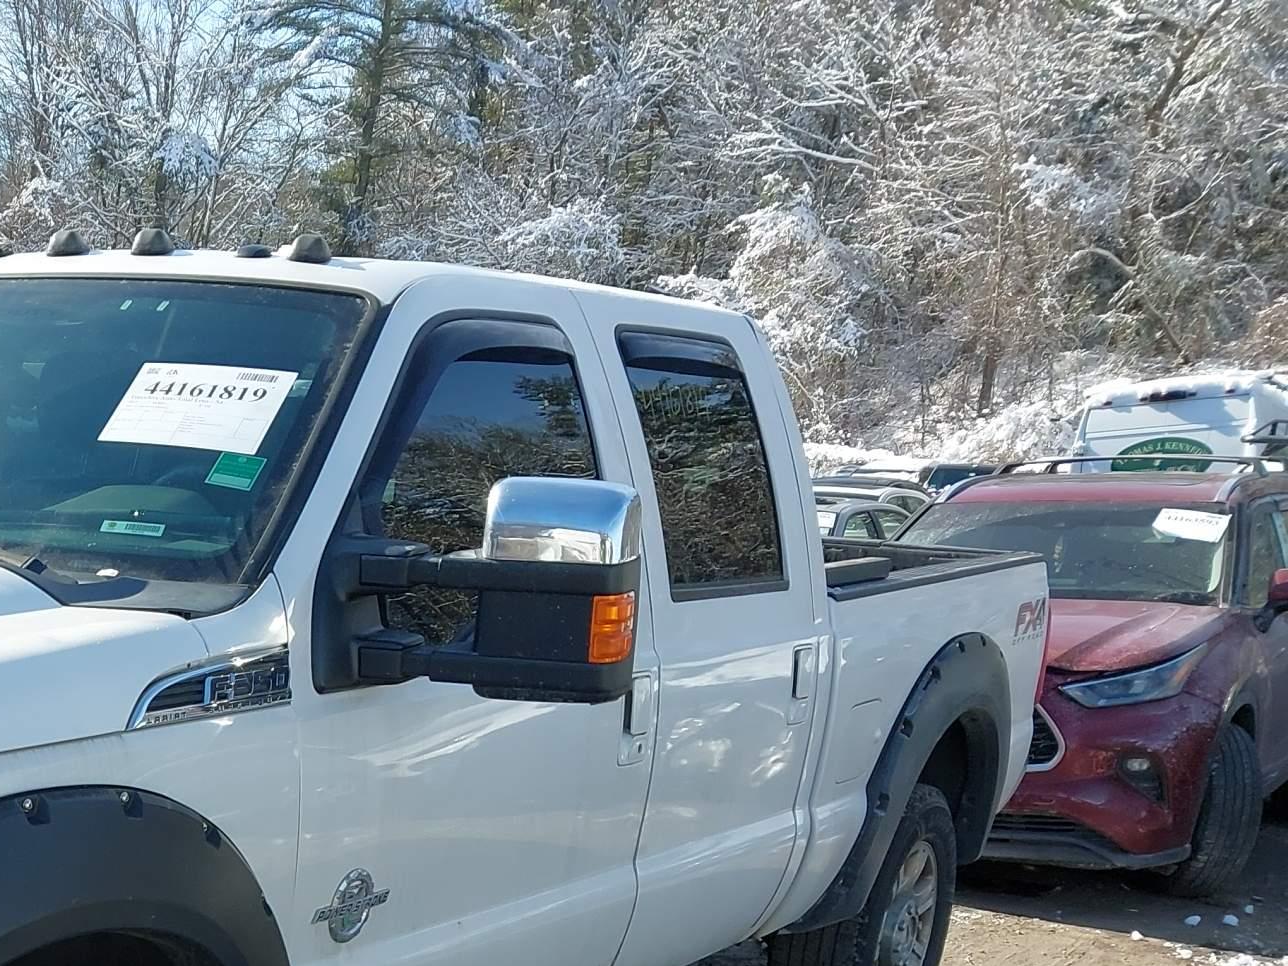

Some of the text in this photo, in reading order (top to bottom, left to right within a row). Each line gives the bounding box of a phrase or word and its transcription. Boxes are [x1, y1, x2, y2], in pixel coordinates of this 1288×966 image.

[144, 380, 268, 403] 44161819
[1014, 598, 1045, 637] FX4
[145, 710, 187, 725] LARIAT
